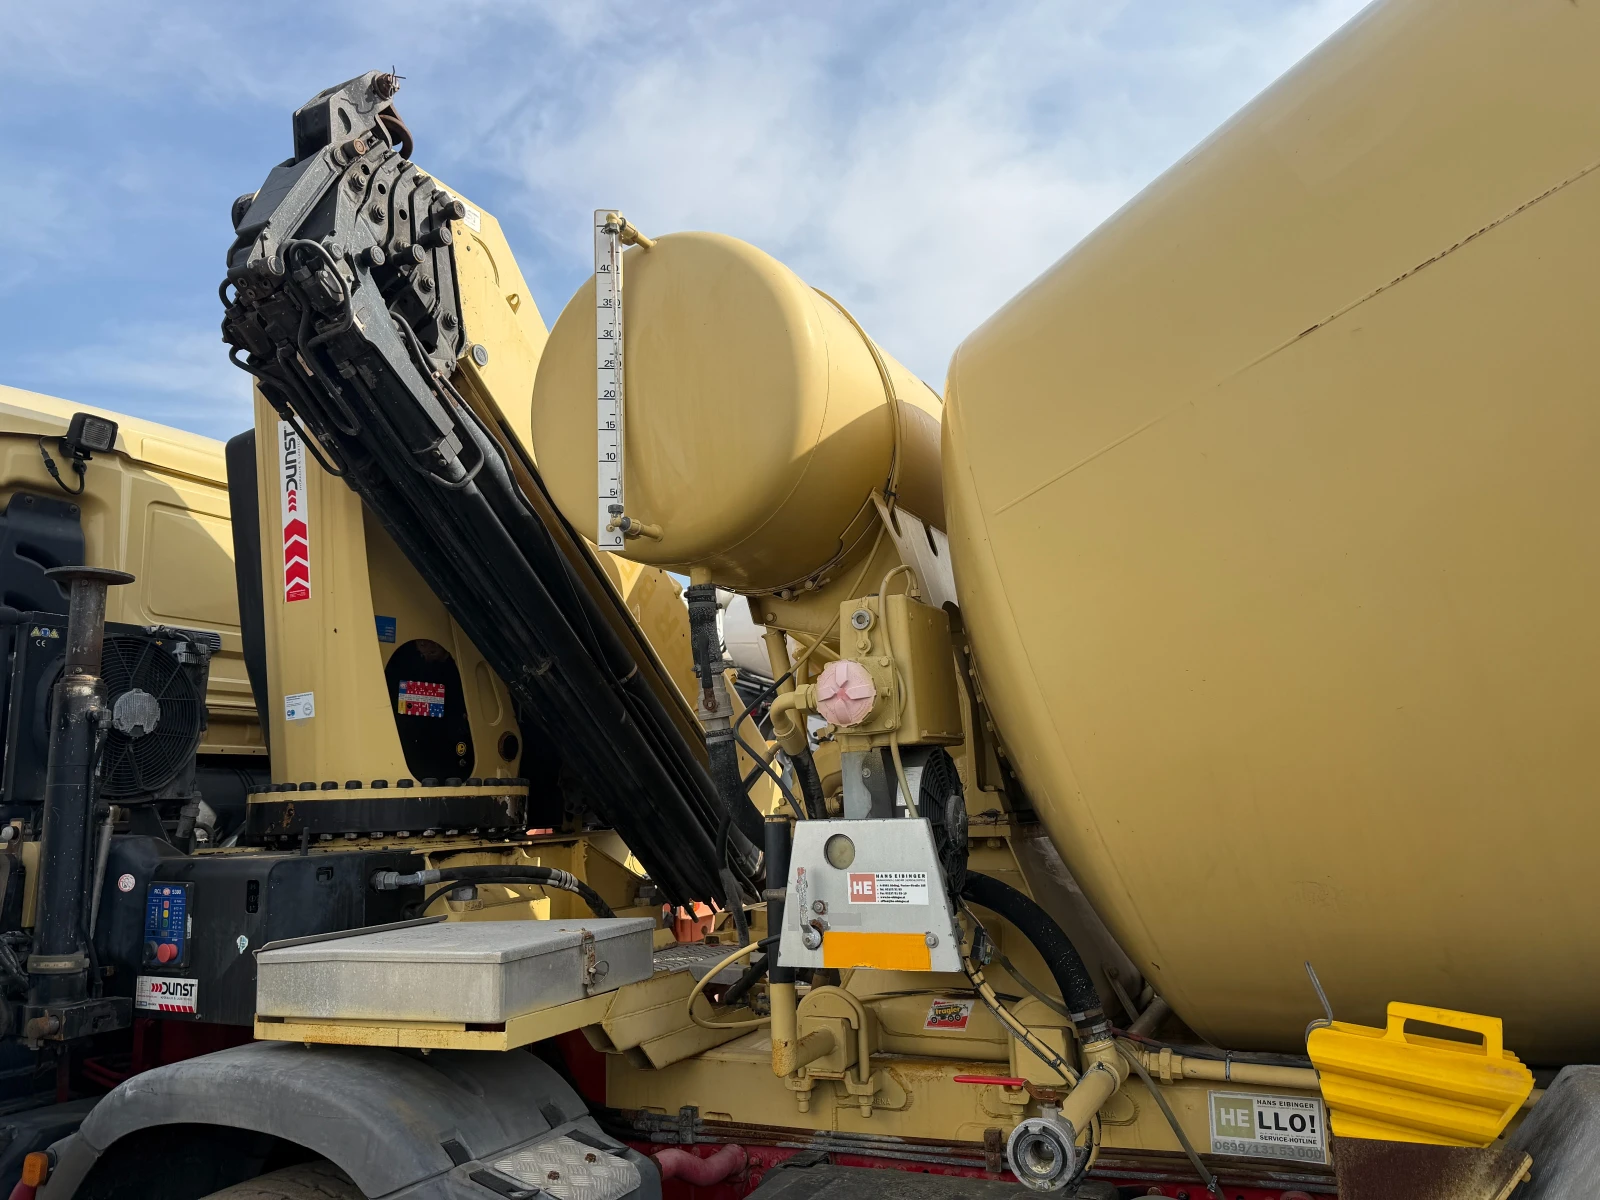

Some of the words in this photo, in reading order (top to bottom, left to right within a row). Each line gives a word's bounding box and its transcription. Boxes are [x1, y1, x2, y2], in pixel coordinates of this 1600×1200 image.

[604, 359, 622, 367] 25
[615, 536, 622, 544] 0
[852, 880, 873, 895] HE
[161, 981, 195, 997] DUNST
[1279, 1100, 1315, 1109] EIBINGER
[1220, 1107, 1250, 1128] HE
[1257, 1110, 1316, 1134] LLO!
[1259, 1134, 1318, 1145] SERVICE-HOTLINE
